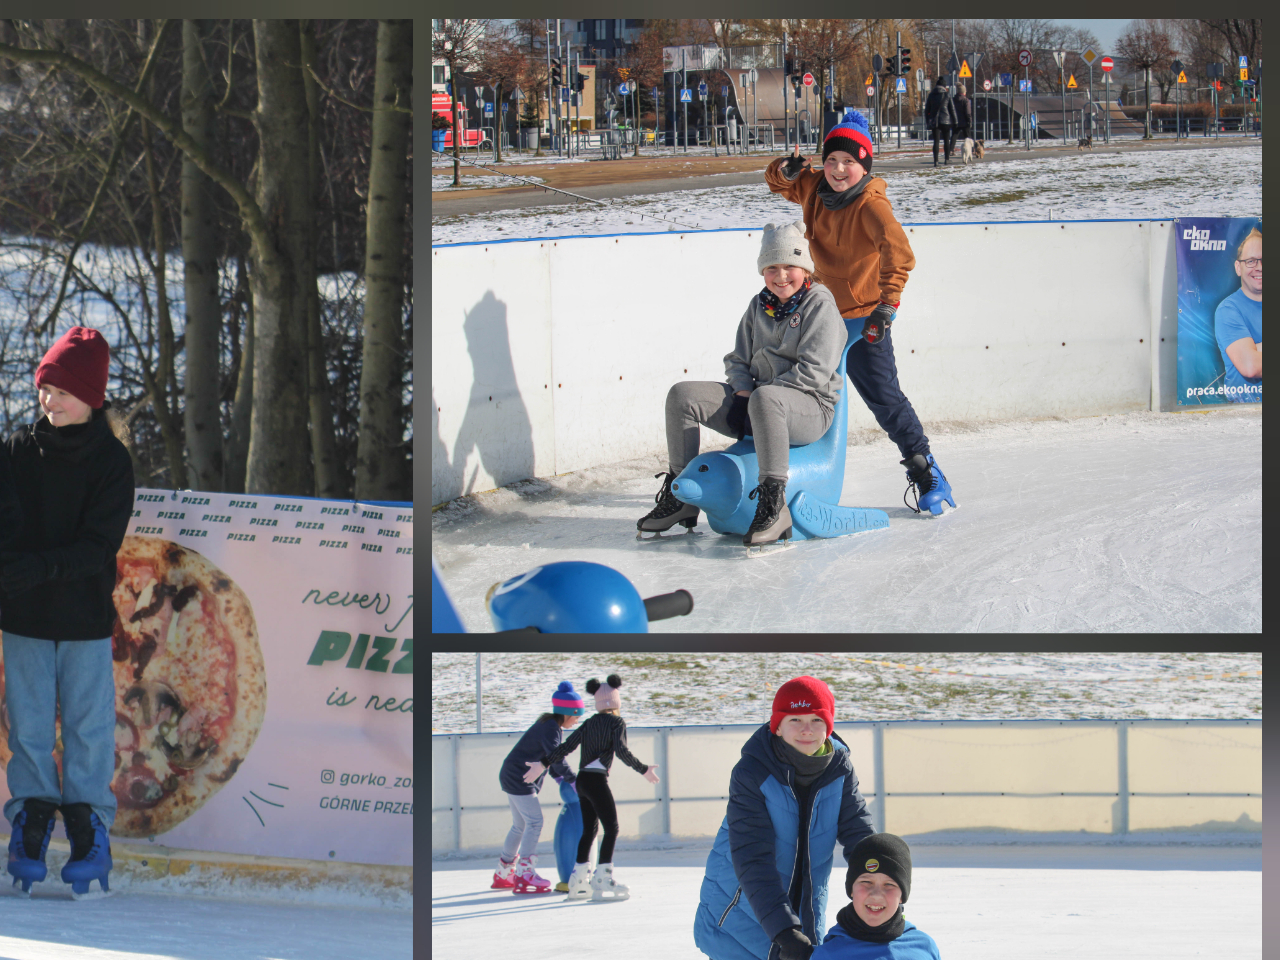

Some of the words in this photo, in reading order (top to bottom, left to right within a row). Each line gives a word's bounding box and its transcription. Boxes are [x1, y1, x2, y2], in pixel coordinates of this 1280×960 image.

[1187, 384, 1262, 398] praca.ekookna
[137, 494, 165, 502] PIZZA
[182, 496, 210, 506] PIZZA
[228, 500, 257, 509] PIZZA
[274, 504, 302, 512] PIZZA
[320, 507, 350, 516] PIZZA
[362, 510, 382, 520] PIZZA
[396, 514, 413, 522] PIZ
[157, 511, 185, 520] PIZZA
[202, 514, 231, 523] PIZZA
[250, 518, 278, 526] PIZZA
[295, 521, 324, 530] PIZZA
[342, 525, 364, 534] PIZZA
[378, 528, 400, 538] PIZZA
[135, 526, 162, 534] PIZZA
[179, 528, 207, 537] PIZZA
[227, 532, 256, 542] PIZZA
[272, 536, 301, 544] PIZZA
[320, 540, 348, 548] PIZZA
[362, 543, 382, 552] PIZZA
[302, 589, 390, 614] never
[307, 630, 413, 674] PIZZ
[326, 687, 357, 706] is
[365, 694, 413, 712] nea
[320, 796, 370, 812] GÓRNE
